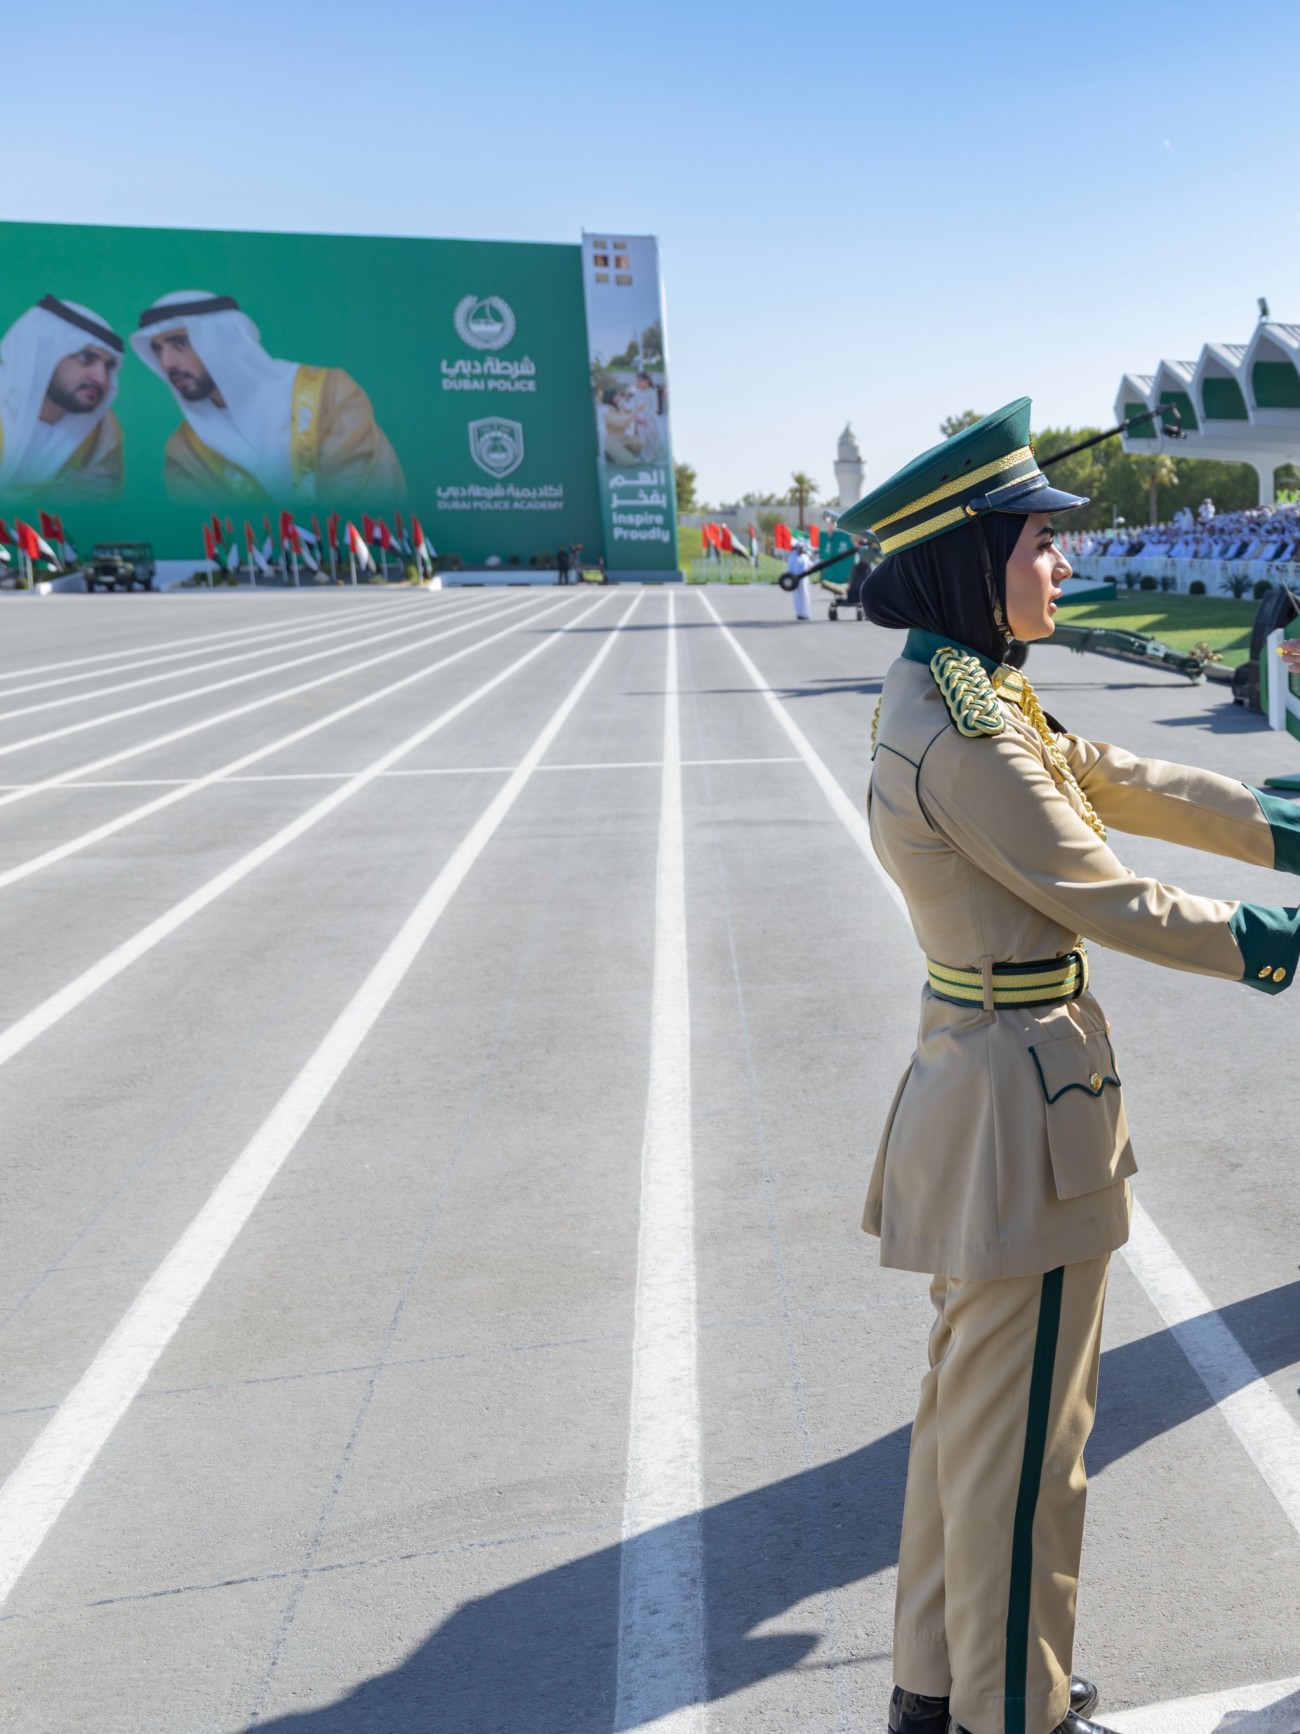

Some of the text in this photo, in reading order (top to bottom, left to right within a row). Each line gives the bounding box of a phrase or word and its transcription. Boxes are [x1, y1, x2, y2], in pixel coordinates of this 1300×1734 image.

[441, 354, 536, 380] شرطة دبي
[442, 379, 537, 392] DUBAI POLICE
[437, 500, 565, 511] DUBAI POLICE ACADEMY
[612, 511, 665, 528] Inspire
[613, 527, 671, 544] Proudly
